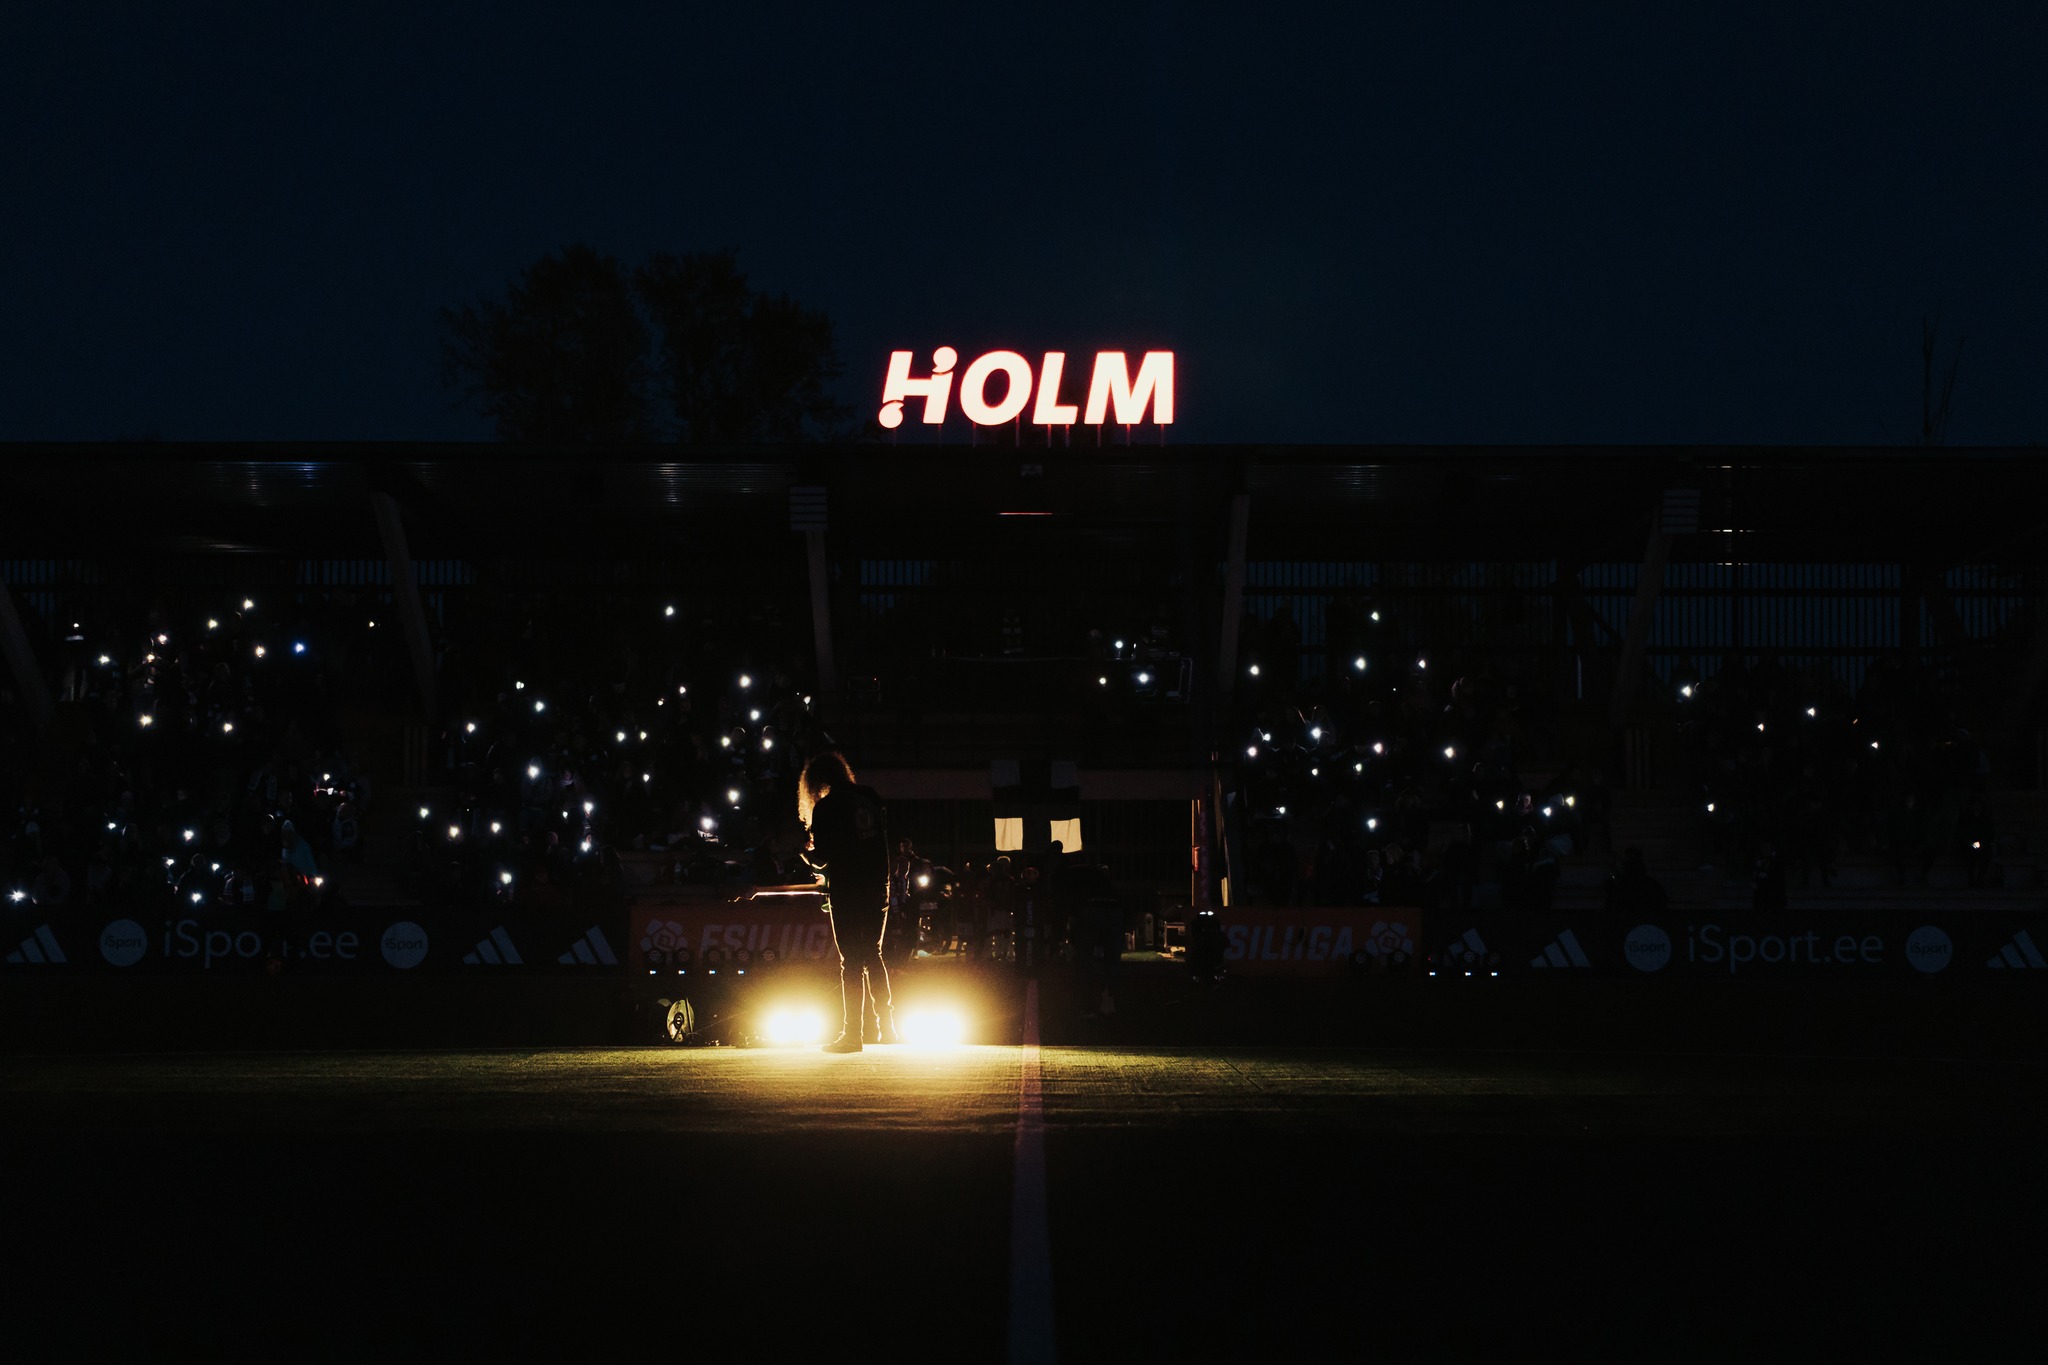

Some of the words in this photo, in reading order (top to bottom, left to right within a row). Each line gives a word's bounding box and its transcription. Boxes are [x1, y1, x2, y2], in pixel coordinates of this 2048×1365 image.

[878, 346, 1174, 428] HOLM
[104, 935, 142, 949] iSport
[164, 919, 360, 969] iSpo.ee
[386, 937, 424, 951] iSport
[699, 924, 836, 960] ESILIIG
[1219, 925, 1353, 961] SILIIGA
[1628, 940, 1666, 954] iSport
[1687, 923, 1885, 973] iSport.ee
[1911, 941, 1949, 955] iSport
